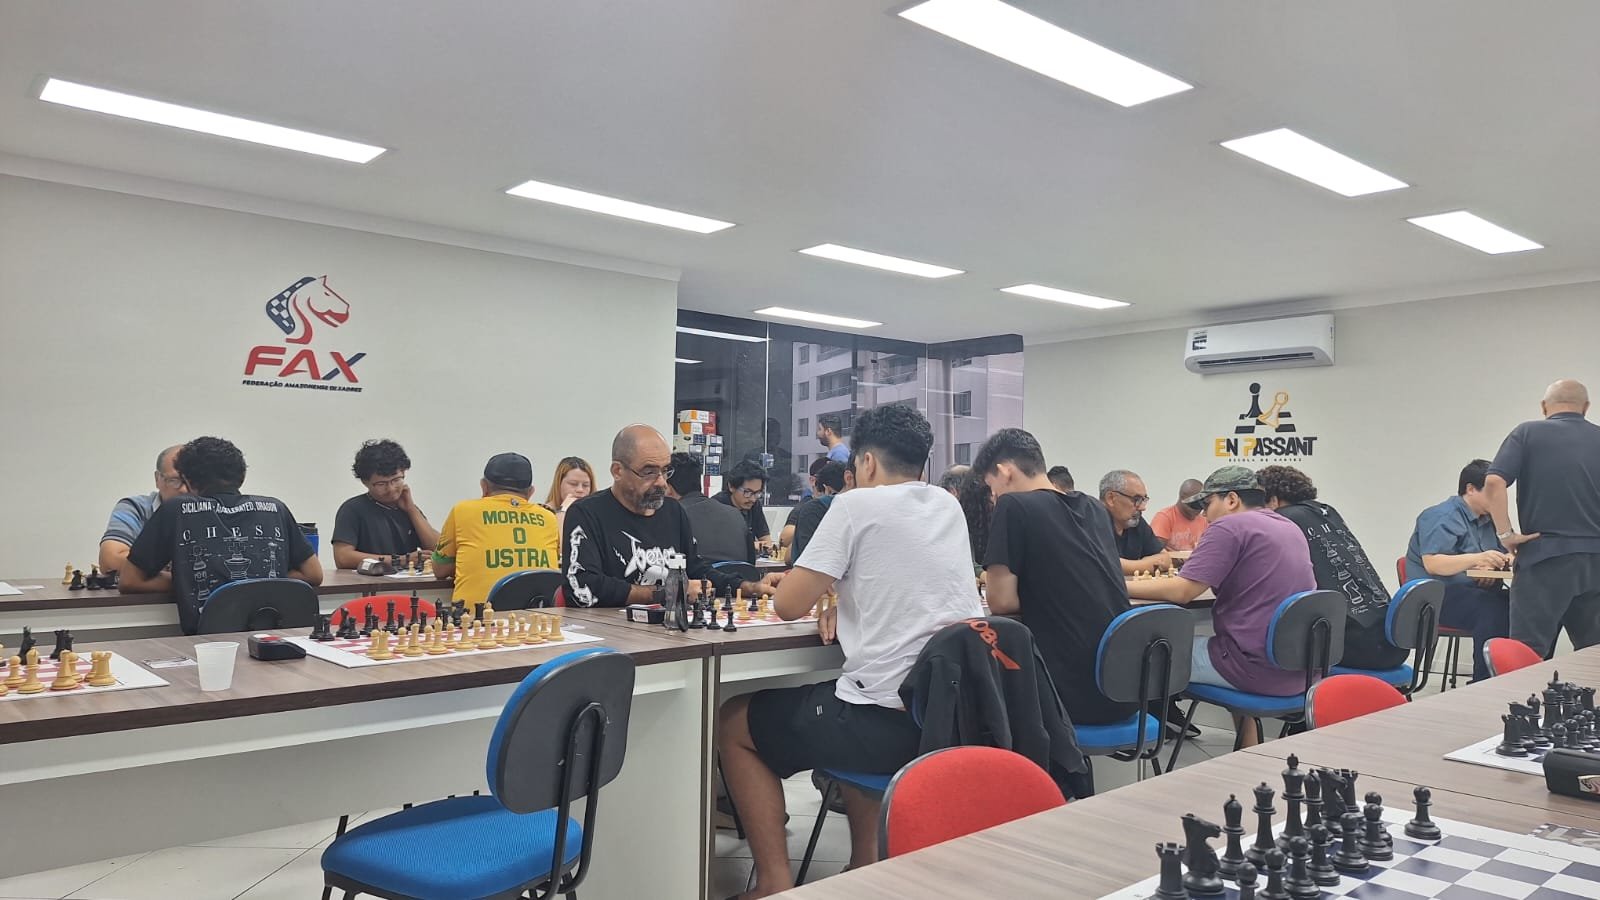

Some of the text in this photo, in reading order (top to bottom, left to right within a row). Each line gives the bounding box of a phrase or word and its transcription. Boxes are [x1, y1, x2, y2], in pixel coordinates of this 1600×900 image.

[244, 345, 367, 383] FAX
[242, 379, 283, 388] FEDERAÇÃO
[1214, 436, 1318, 457] EN PASSANT
[482, 510, 545, 527] MORAES
[183, 524, 282, 541] CHESS
[485, 548, 550, 569] USTRA
